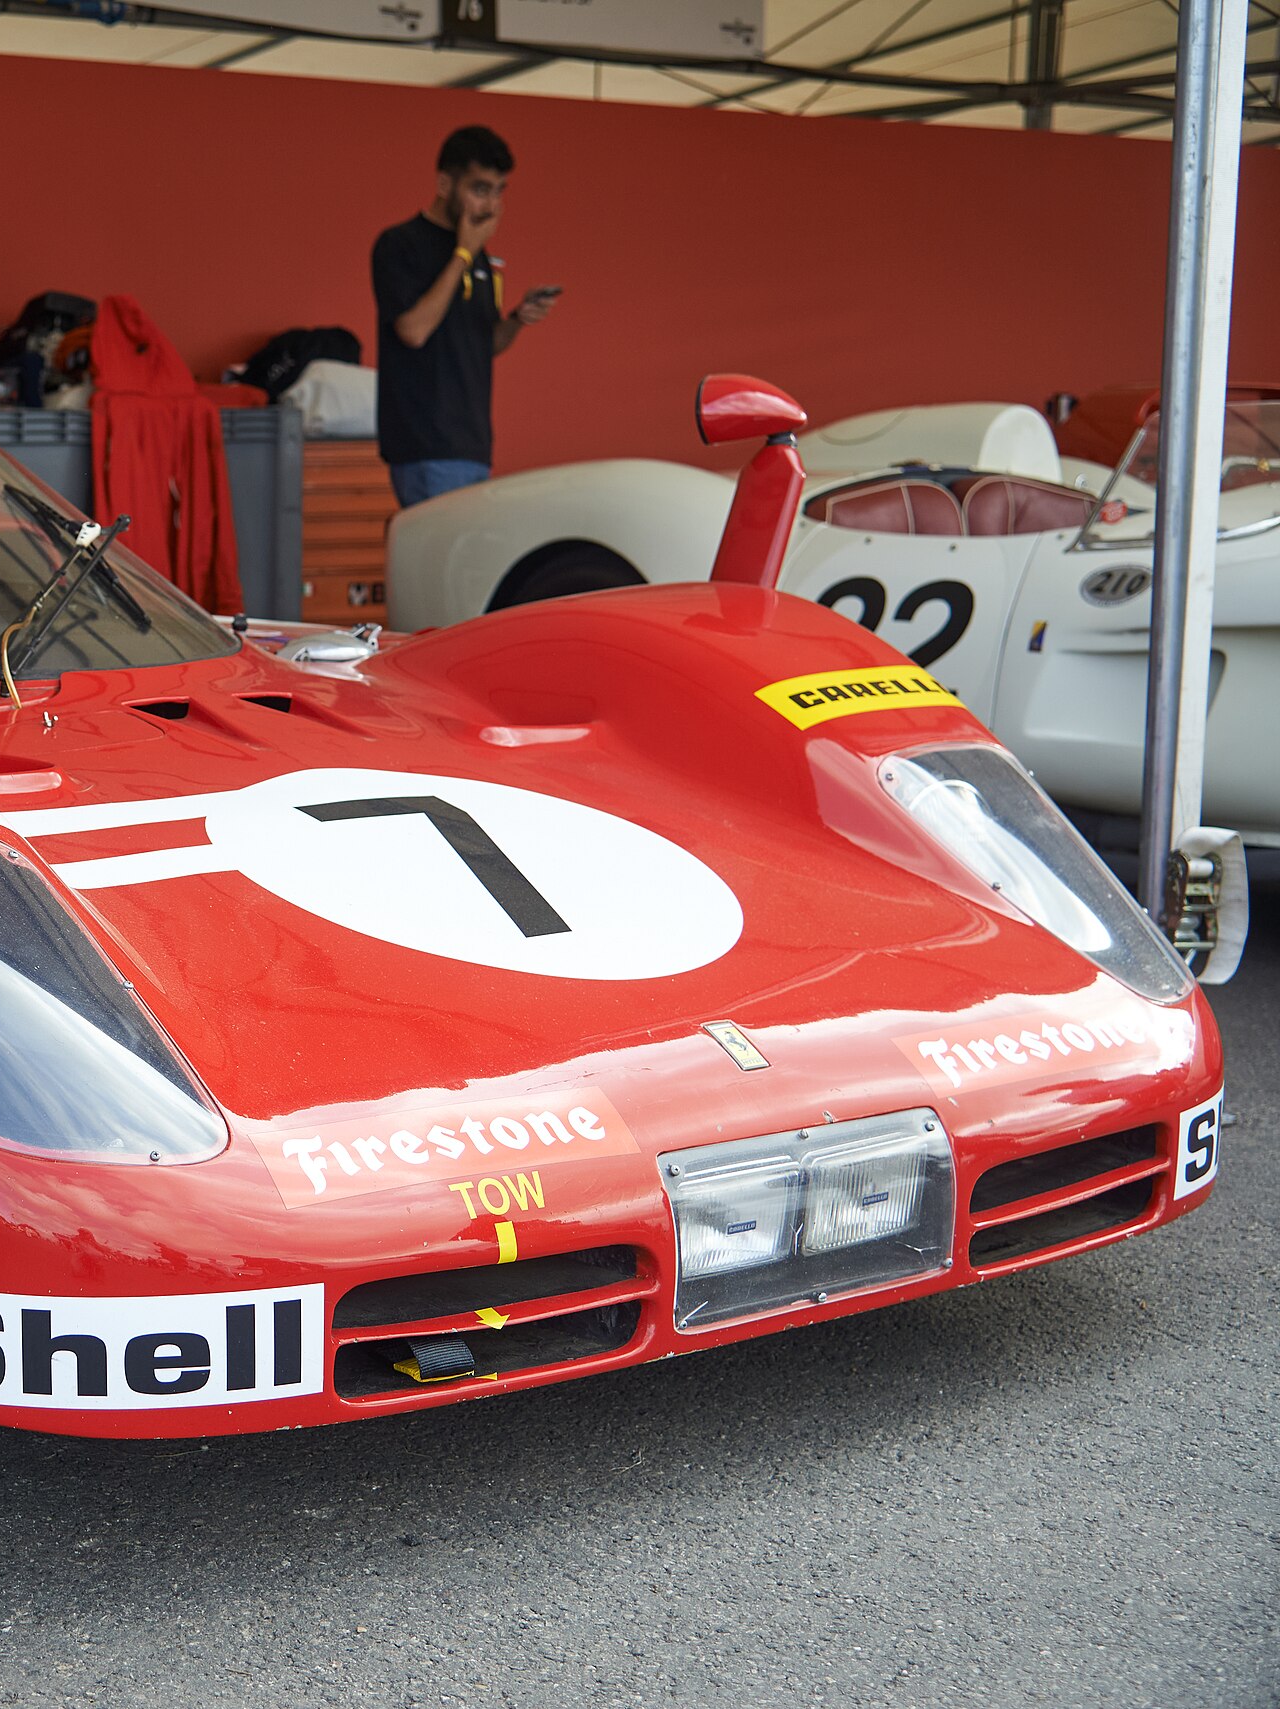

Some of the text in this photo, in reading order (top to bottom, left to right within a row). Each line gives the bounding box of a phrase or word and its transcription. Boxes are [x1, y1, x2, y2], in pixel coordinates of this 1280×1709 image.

[1088, 570, 1147, 595] 210
[293, 795, 572, 938] 7
[918, 1016, 1148, 1089] Firestone
[282, 1106, 606, 1196] Firestone
[448, 1171, 546, 1220] TOW
